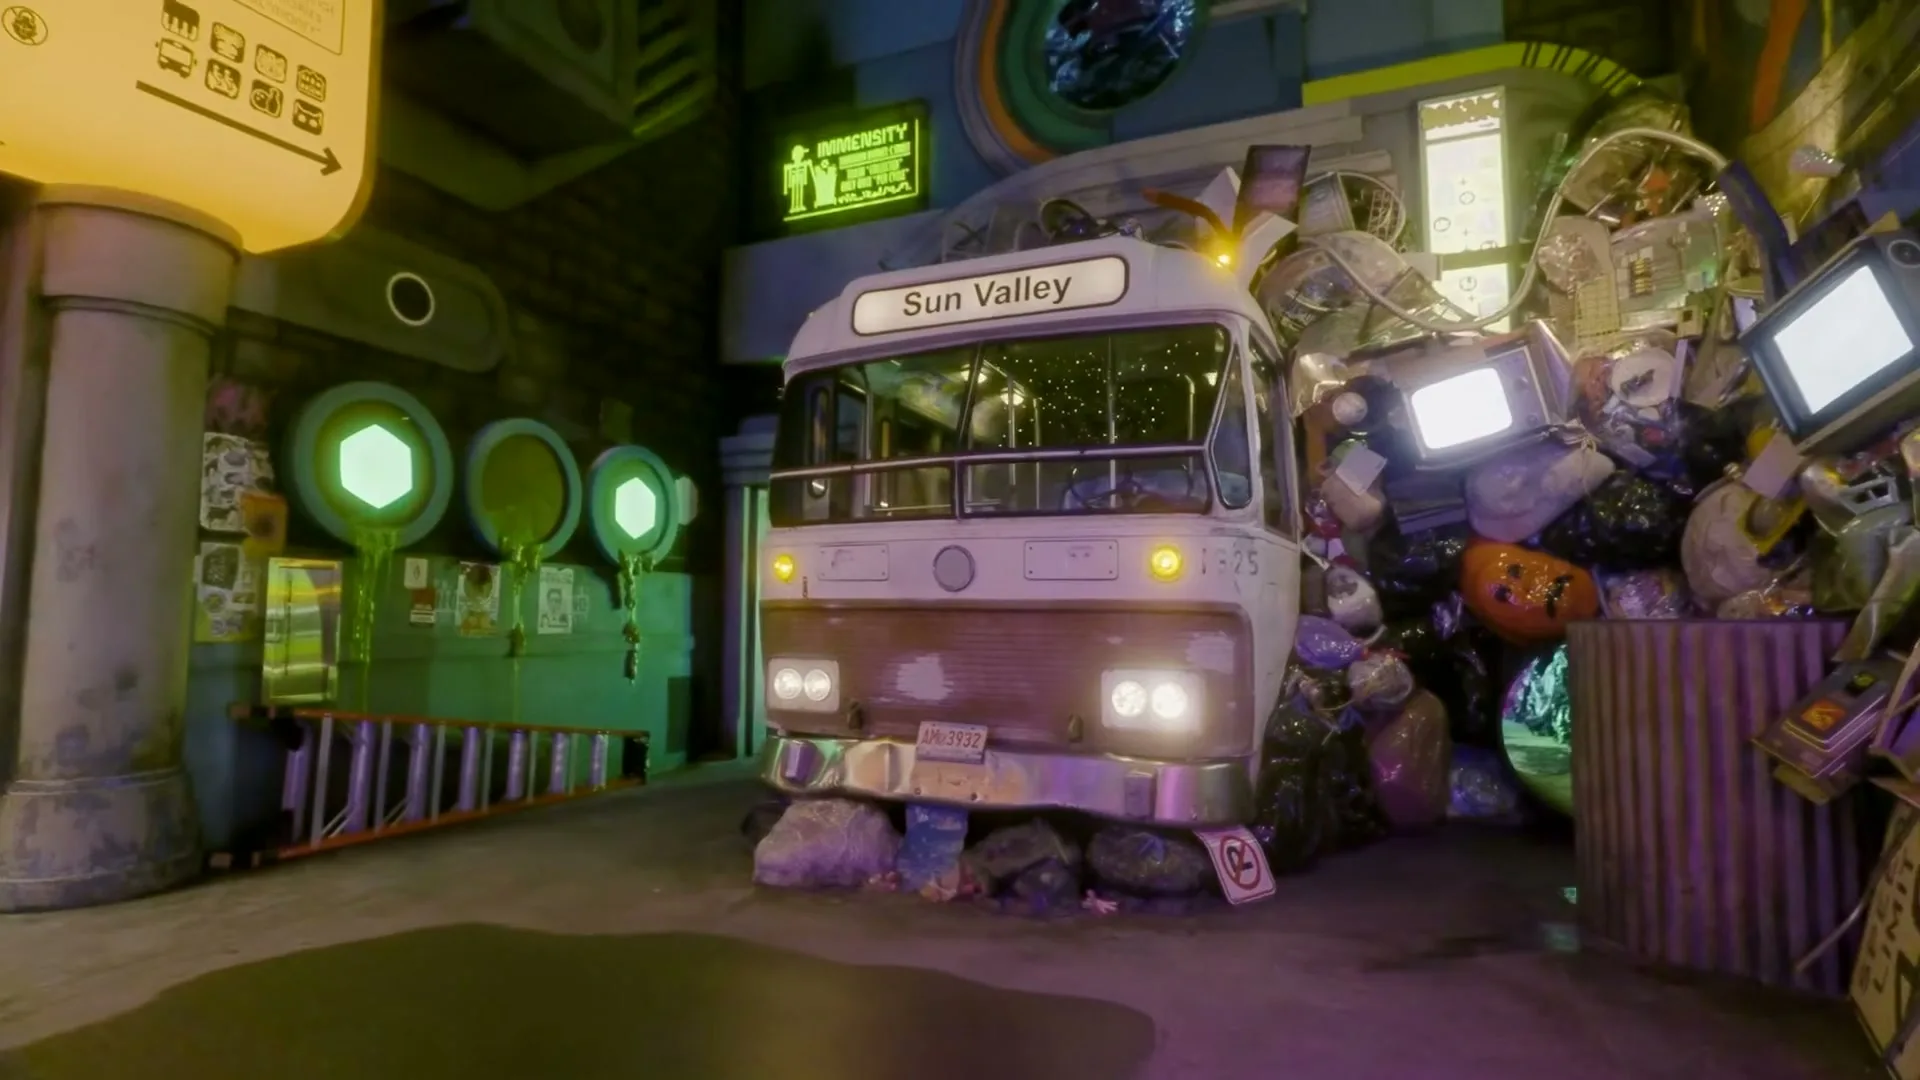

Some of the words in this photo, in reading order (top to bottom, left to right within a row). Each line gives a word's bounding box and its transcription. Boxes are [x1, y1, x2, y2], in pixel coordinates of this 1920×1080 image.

[817, 122, 907, 158] IMMENSITY
[903, 291, 962, 316] Sun
[974, 275, 1072, 307] Valley
